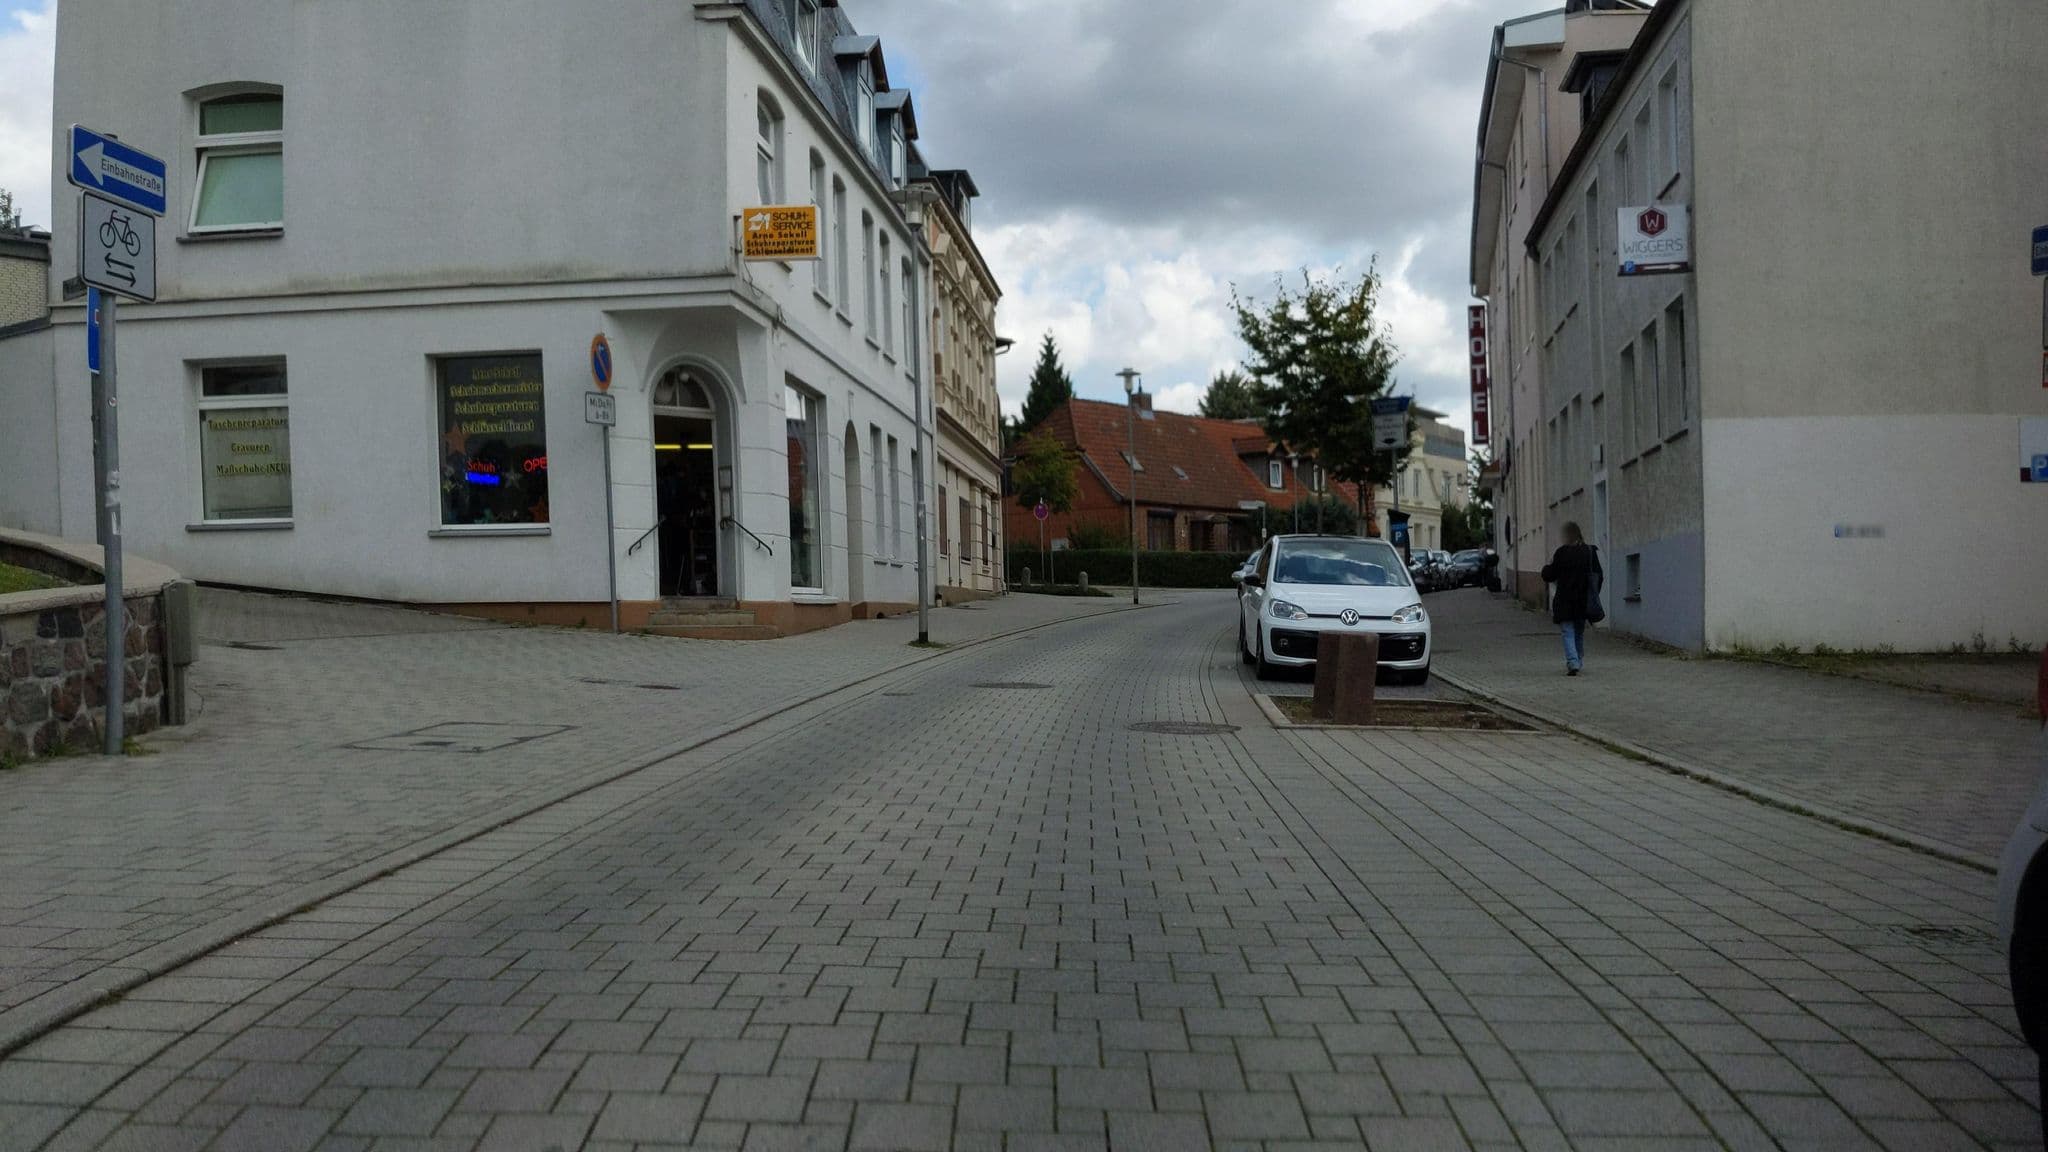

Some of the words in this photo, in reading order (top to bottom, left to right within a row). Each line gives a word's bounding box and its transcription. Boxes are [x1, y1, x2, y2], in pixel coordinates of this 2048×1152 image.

[101, 158, 161, 192] Einbahnstraße
[772, 211, 809, 221] SCHUH-
[772, 221, 813, 231] SERVICE
[1623, 239, 1684, 254] WIGGERS
[1469, 307, 1488, 441] HOTEL
